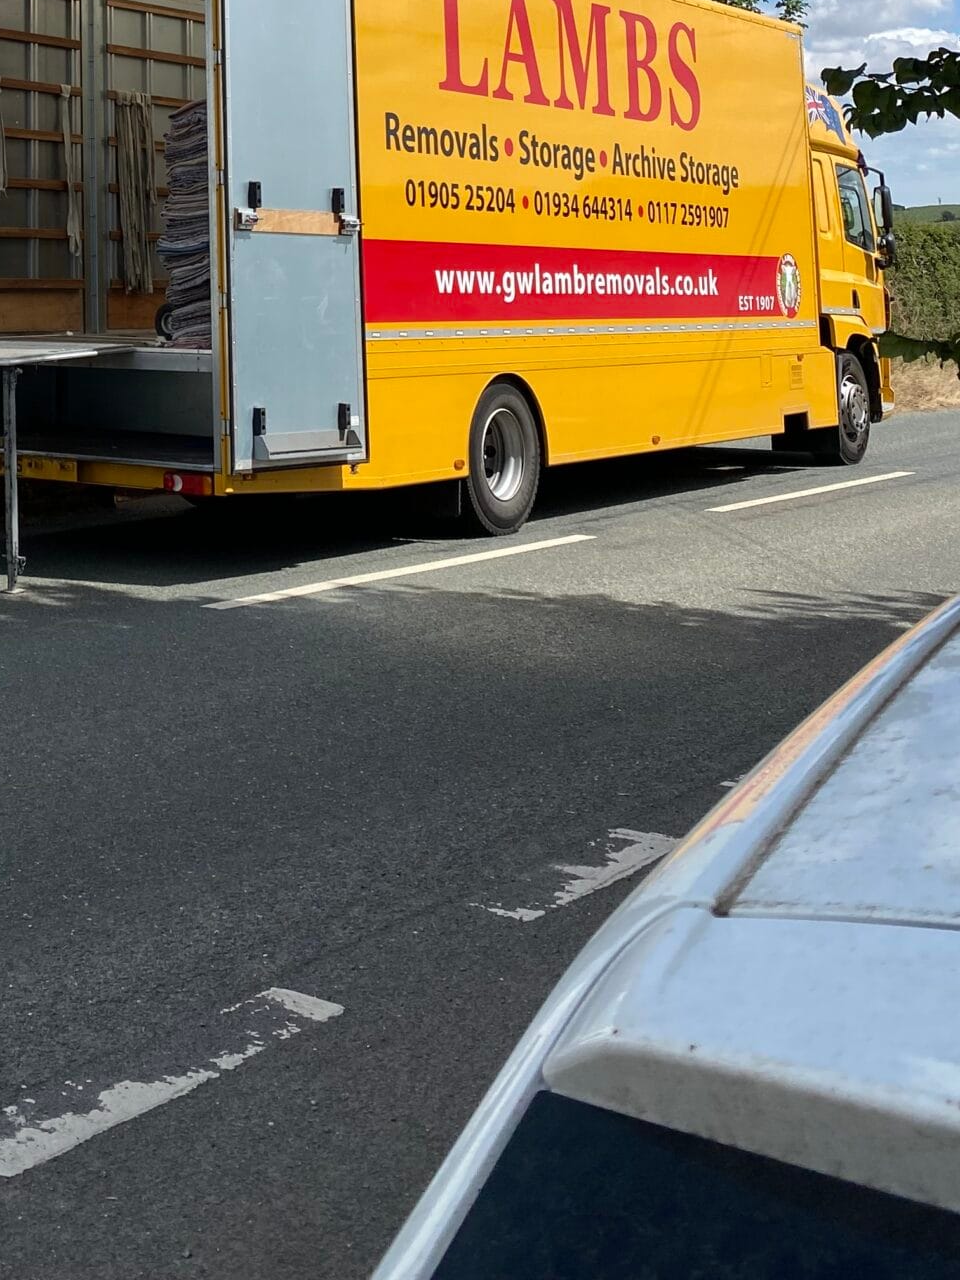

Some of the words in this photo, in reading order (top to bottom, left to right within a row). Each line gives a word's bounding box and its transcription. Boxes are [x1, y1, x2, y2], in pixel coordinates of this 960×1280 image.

[384, 111, 499, 162] Removals
[518, 129, 596, 181] Storage
[612, 142, 676, 182] Archive
[679, 151, 739, 196] Storage
[405, 178, 460, 210] 01905
[465, 184, 516, 214] 25204
[534, 190, 579, 219] 01934
[583, 194, 633, 222] 644314
[647, 200, 677, 225] 0117
[680, 203, 729, 229] 2591907
[435, 263, 719, 303] www.gwlambremovals.co.uk
[738, 295, 753, 311] EST
[754, 296, 775, 311] 1907
